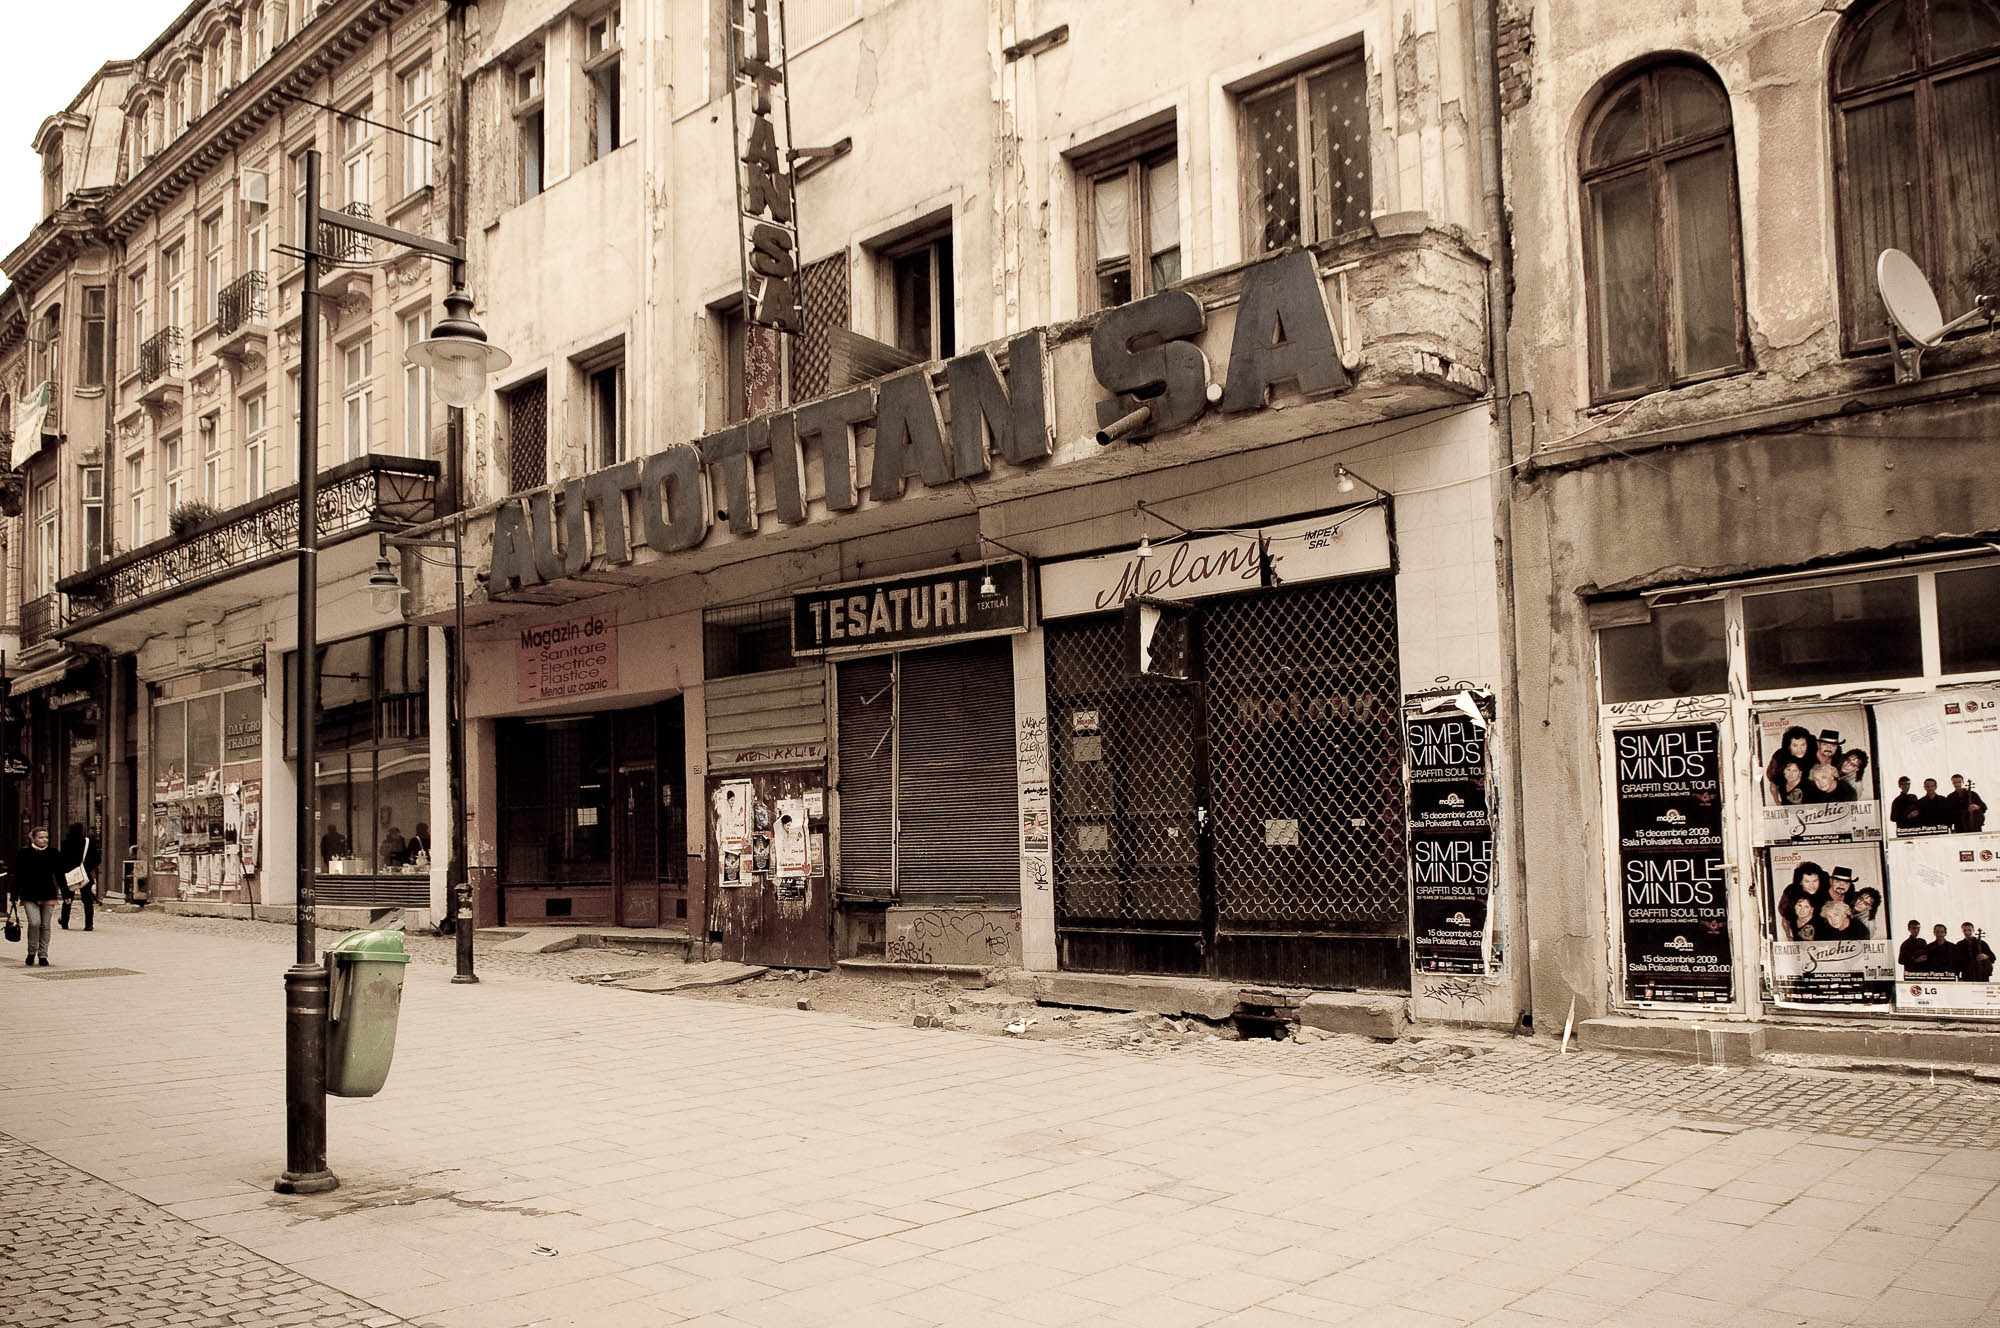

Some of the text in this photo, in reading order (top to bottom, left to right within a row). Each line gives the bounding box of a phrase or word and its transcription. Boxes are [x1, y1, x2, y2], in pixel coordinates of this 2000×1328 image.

[1304, 525, 1340, 541] IMPEX
[1308, 538, 1331, 550] SRL
[1095, 536, 1283, 609] Melany
[521, 621, 580, 650] Magazin
[540, 642, 607, 662] Sanitare
[541, 655, 607, 675] Electrice
[541, 668, 600, 685] Plastice
[578, 679, 608, 692] casnic
[1981, 701, 1994, 709] LG
[1409, 722, 1485, 747] SIMPLE
[228, 734, 261, 750] TRADING
[1620, 730, 1714, 758] SIMPLE
[1410, 742, 1481, 767] MINDS
[1410, 768, 1444, 779] GRAFFITI
[1444, 767, 1469, 777] SOUL
[1620, 754, 1706, 781] MINDS
[1622, 780, 1716, 794] GRAFFITI SOUL TOUR
[1420, 810, 1485, 820] 15 decembrie 2009
[1850, 804, 1872, 816] PALAT
[1410, 820, 1425, 828] Sala
[1635, 827, 1710, 838] 15 decembrie 2009
[1622, 838, 1640, 846] Sala
[1699, 836, 1722, 844] 20:00
[1415, 840, 1493, 862] SIMPLE
[1774, 854, 1802, 862] Europa
[1416, 862, 1489, 884] MINDS
[1626, 858, 1722, 882] SIMPLE
[1416, 886, 1450, 896] GRAFFITI
[1451, 886, 1476, 896] SOUL
[1627, 881, 1714, 905] MINDS
[1628, 908, 1726, 918] GRAFFITI SOUL TOUR
[1428, 929, 1436, 937] 15
[1436, 929, 1472, 938] decembrie
[1416, 937, 1432, 945] Sala
[1864, 943, 1885, 954] PALAT
[1642, 955, 1718, 964] 15 decembrie 2009
[1629, 964, 1648, 972] Sala
[1708, 964, 1730, 972] 20:00
